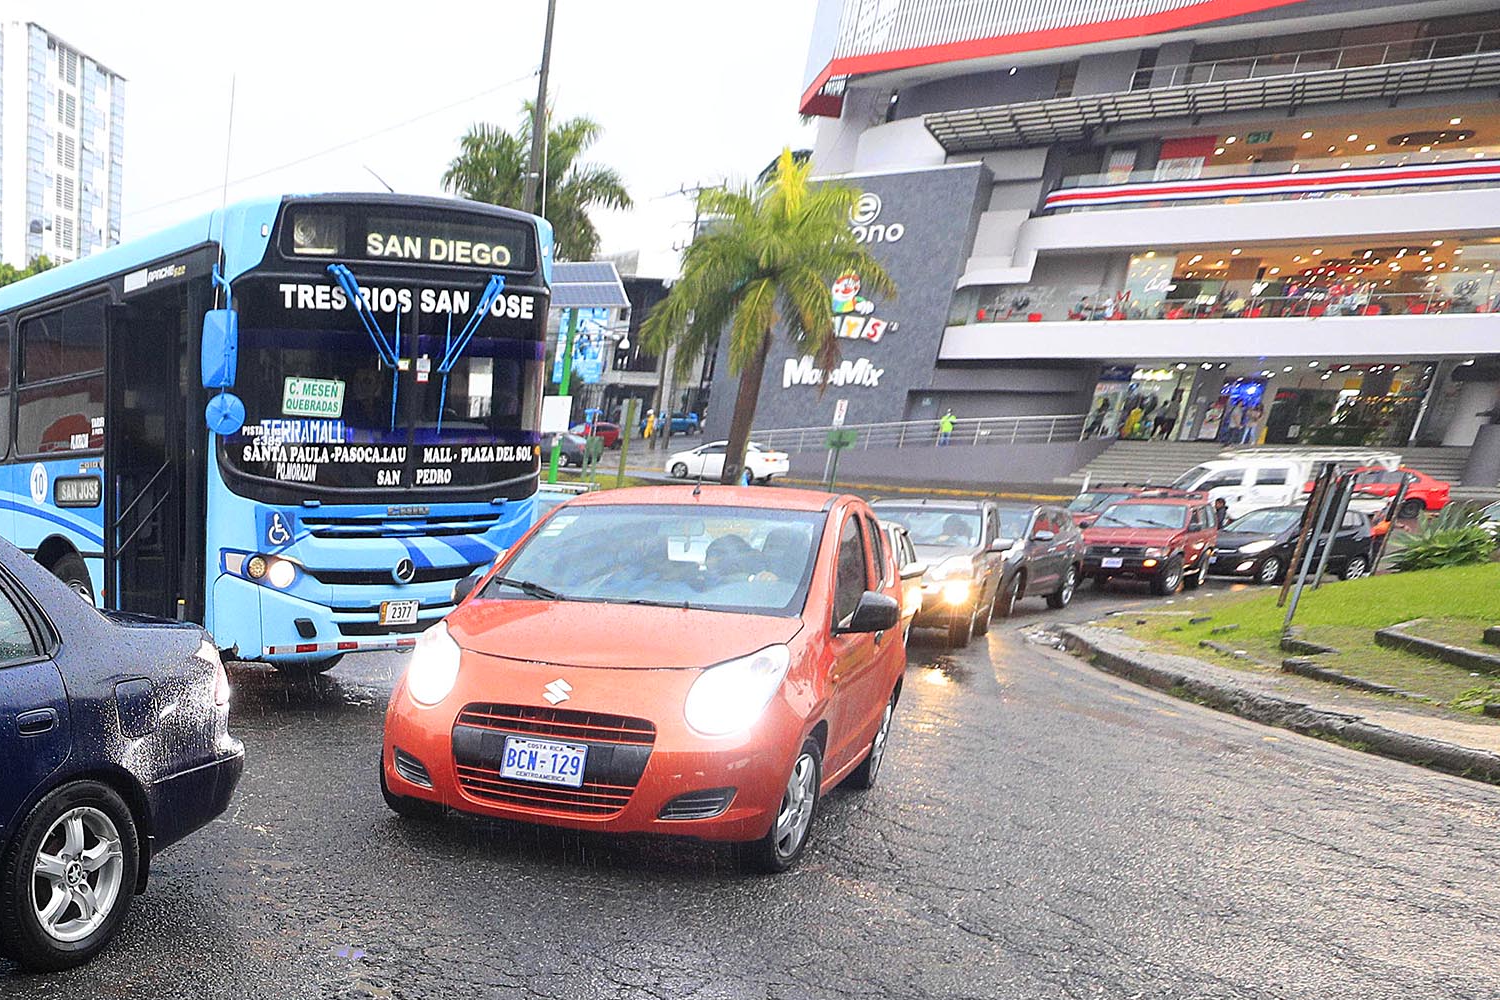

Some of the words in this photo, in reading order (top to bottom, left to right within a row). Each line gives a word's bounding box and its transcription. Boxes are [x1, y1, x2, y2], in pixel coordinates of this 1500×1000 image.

[366, 232, 422, 259] SAN
[429, 238, 511, 267] DIEGO
[279, 283, 347, 310] TRES
[356, 287, 412, 313] RIOS
[420, 288, 470, 314] SAN
[289, 382, 299, 395] C.
[302, 383, 339, 398] MESEN
[285, 399, 339, 413] QUEBRADAS
[241, 425, 264, 436] PISTA
[260, 419, 345, 444] TERRAMALL
[242, 444, 288, 462] SANTA
[289, 446, 329, 463] PAULA
[423, 447, 452, 463] MALL
[460, 446, 494, 463] PLAZA
[495, 446, 515, 462] DEL
[517, 446, 533, 461] SOL
[34, 473, 44, 496] 10
[376, 470, 401, 485] SAN
[415, 469, 451, 484] PEDRO
[61, 483, 78, 501] SAN
[391, 606, 412, 619] 2377
[506, 747, 581, 776] BCN-129
[516, 770, 566, 782] CENTROAMERICA
